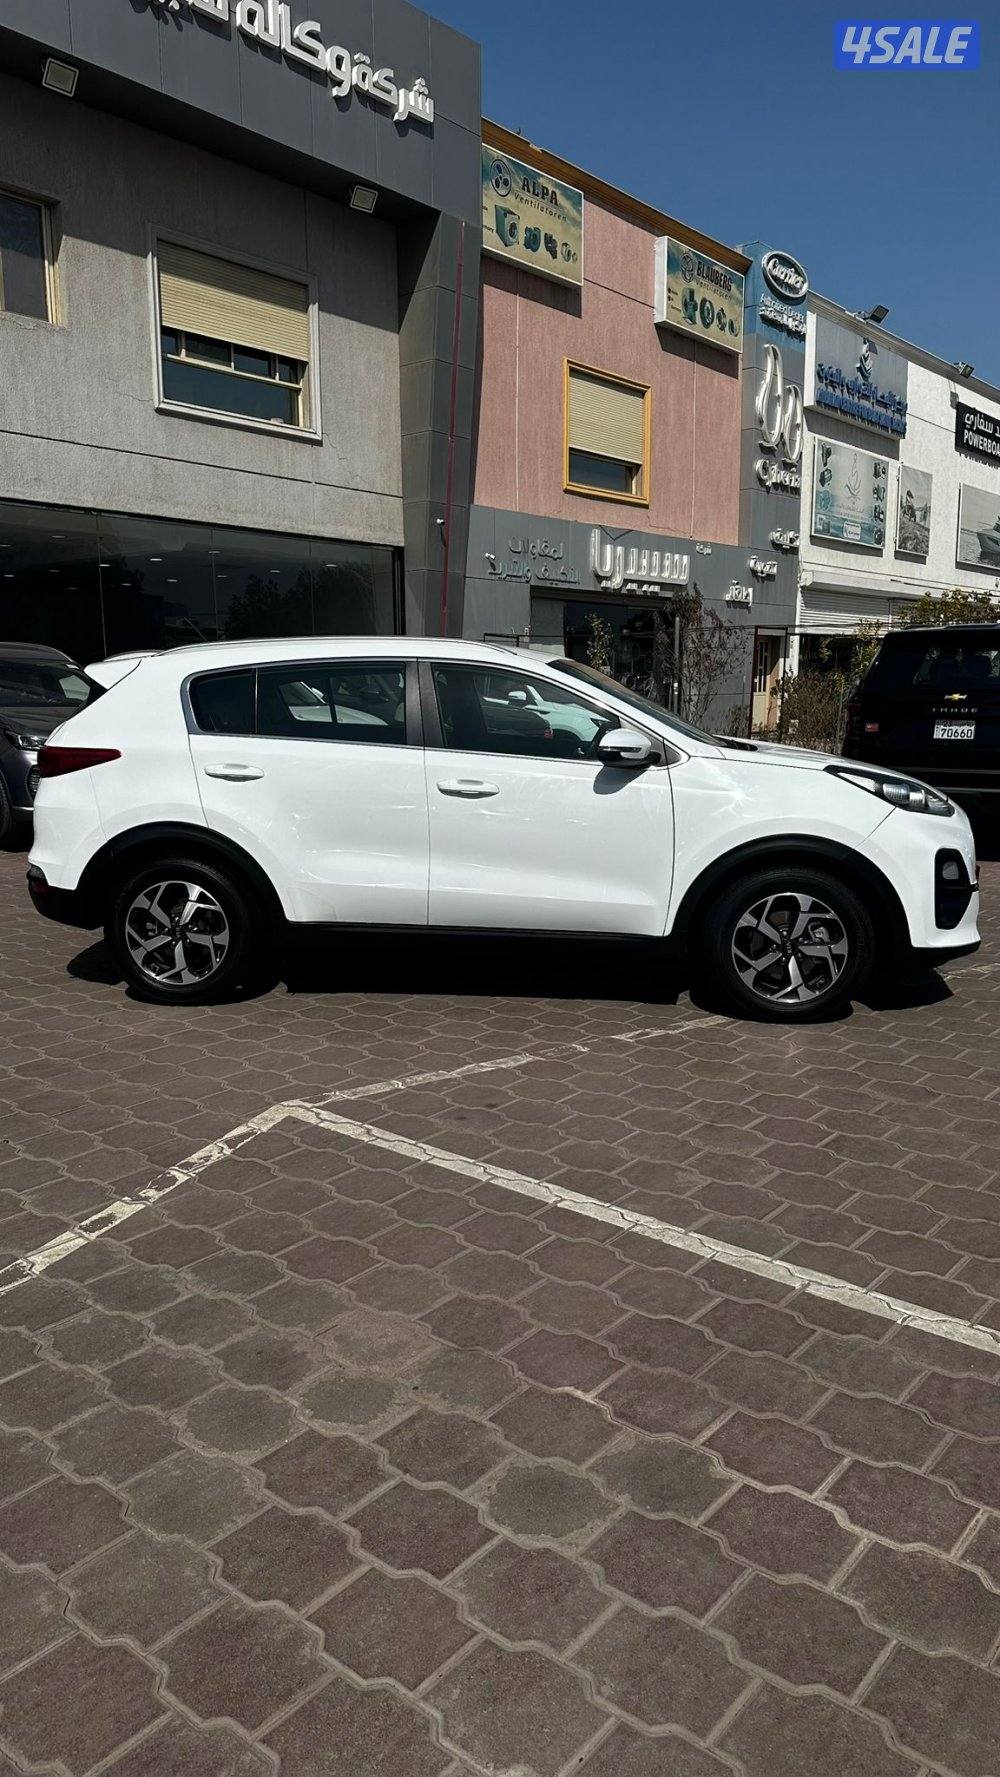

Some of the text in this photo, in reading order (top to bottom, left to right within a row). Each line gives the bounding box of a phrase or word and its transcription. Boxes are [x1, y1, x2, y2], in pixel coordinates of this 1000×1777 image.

[352, 52, 434, 124] شركة
[514, 192, 567, 222] Ventilatoren
[521, 176, 559, 207] ALPA
[696, 260, 732, 292] BLAUBERG
[940, 728, 973, 739] 70660
